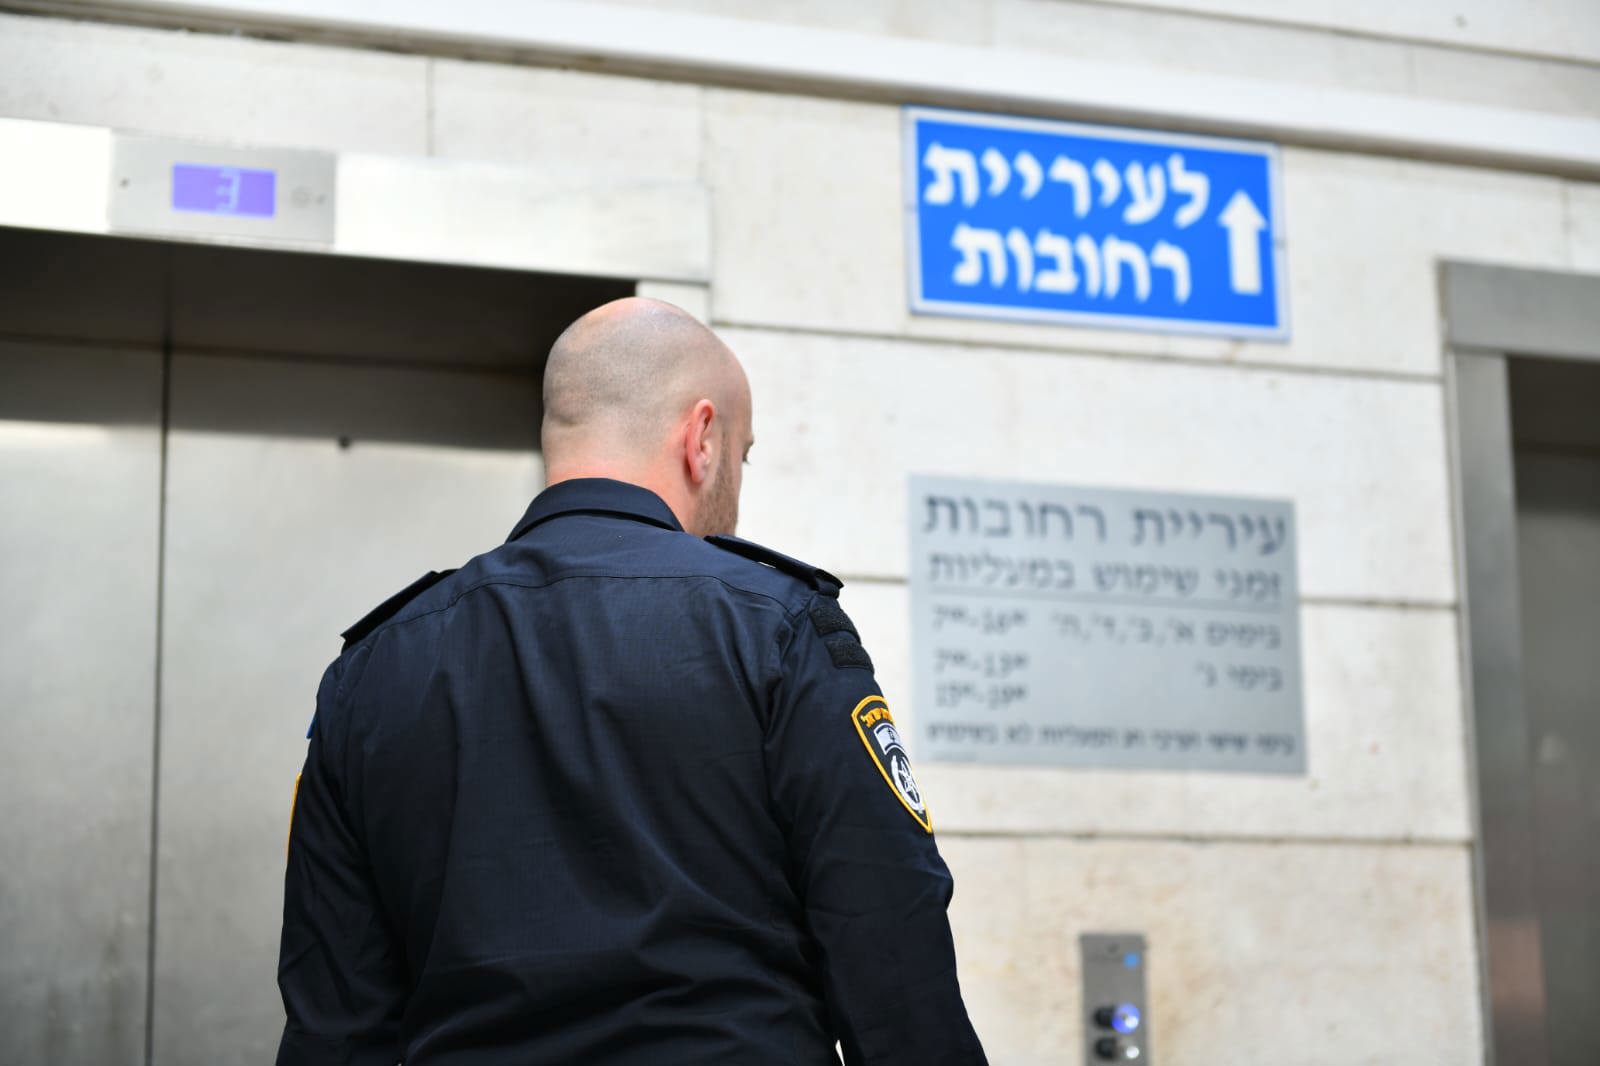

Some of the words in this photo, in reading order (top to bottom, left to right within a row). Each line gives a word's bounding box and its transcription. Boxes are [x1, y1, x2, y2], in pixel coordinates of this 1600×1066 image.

[923, 142, 1210, 229] לעיריית
[951, 222, 1191, 305] רחובות
[922, 494, 1107, 543] רחובות
[1131, 506, 1287, 556] עיריית
[928, 550, 1075, 590] במעליות
[1092, 561, 1200, 596] שימוש
[1213, 568, 1282, 602] זמני
